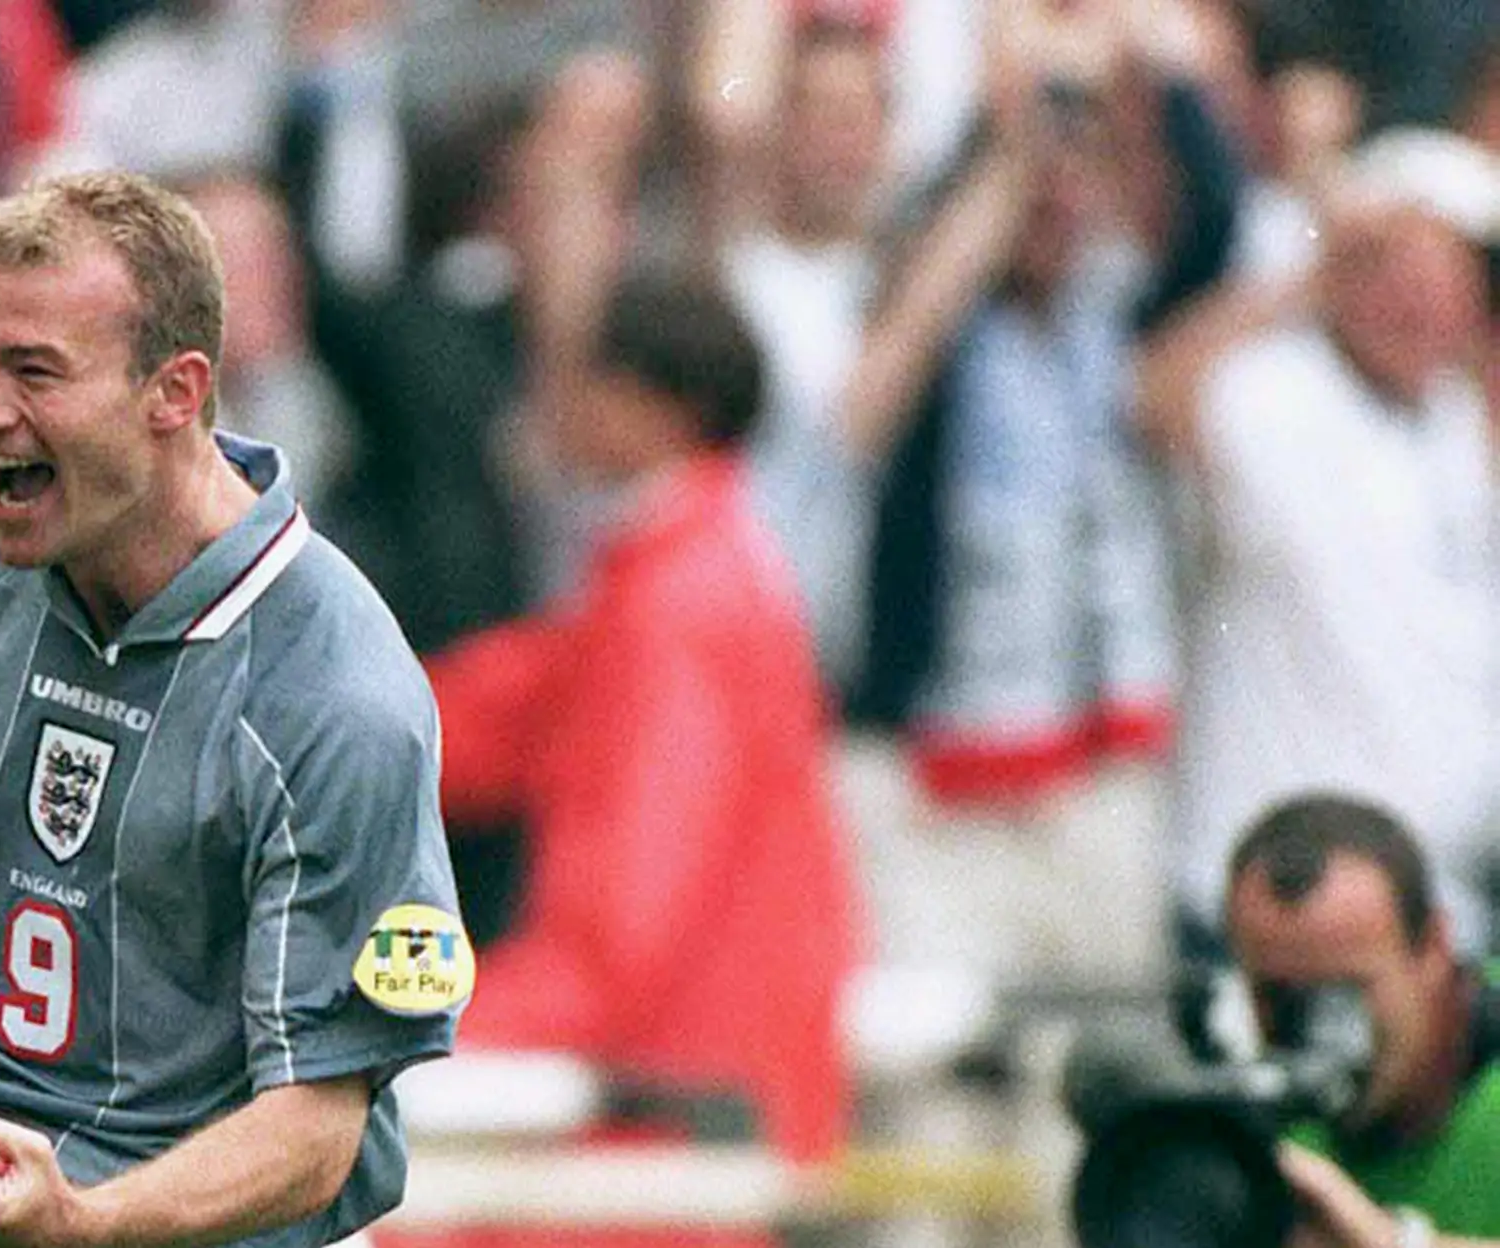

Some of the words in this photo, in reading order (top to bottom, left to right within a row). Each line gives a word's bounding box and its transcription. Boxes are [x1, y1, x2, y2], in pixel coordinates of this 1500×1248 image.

[31, 674, 152, 732] UMBRO
[10, 866, 88, 909] ENGLAND
[374, 971, 411, 993] Fair
[418, 973, 457, 996] Play
